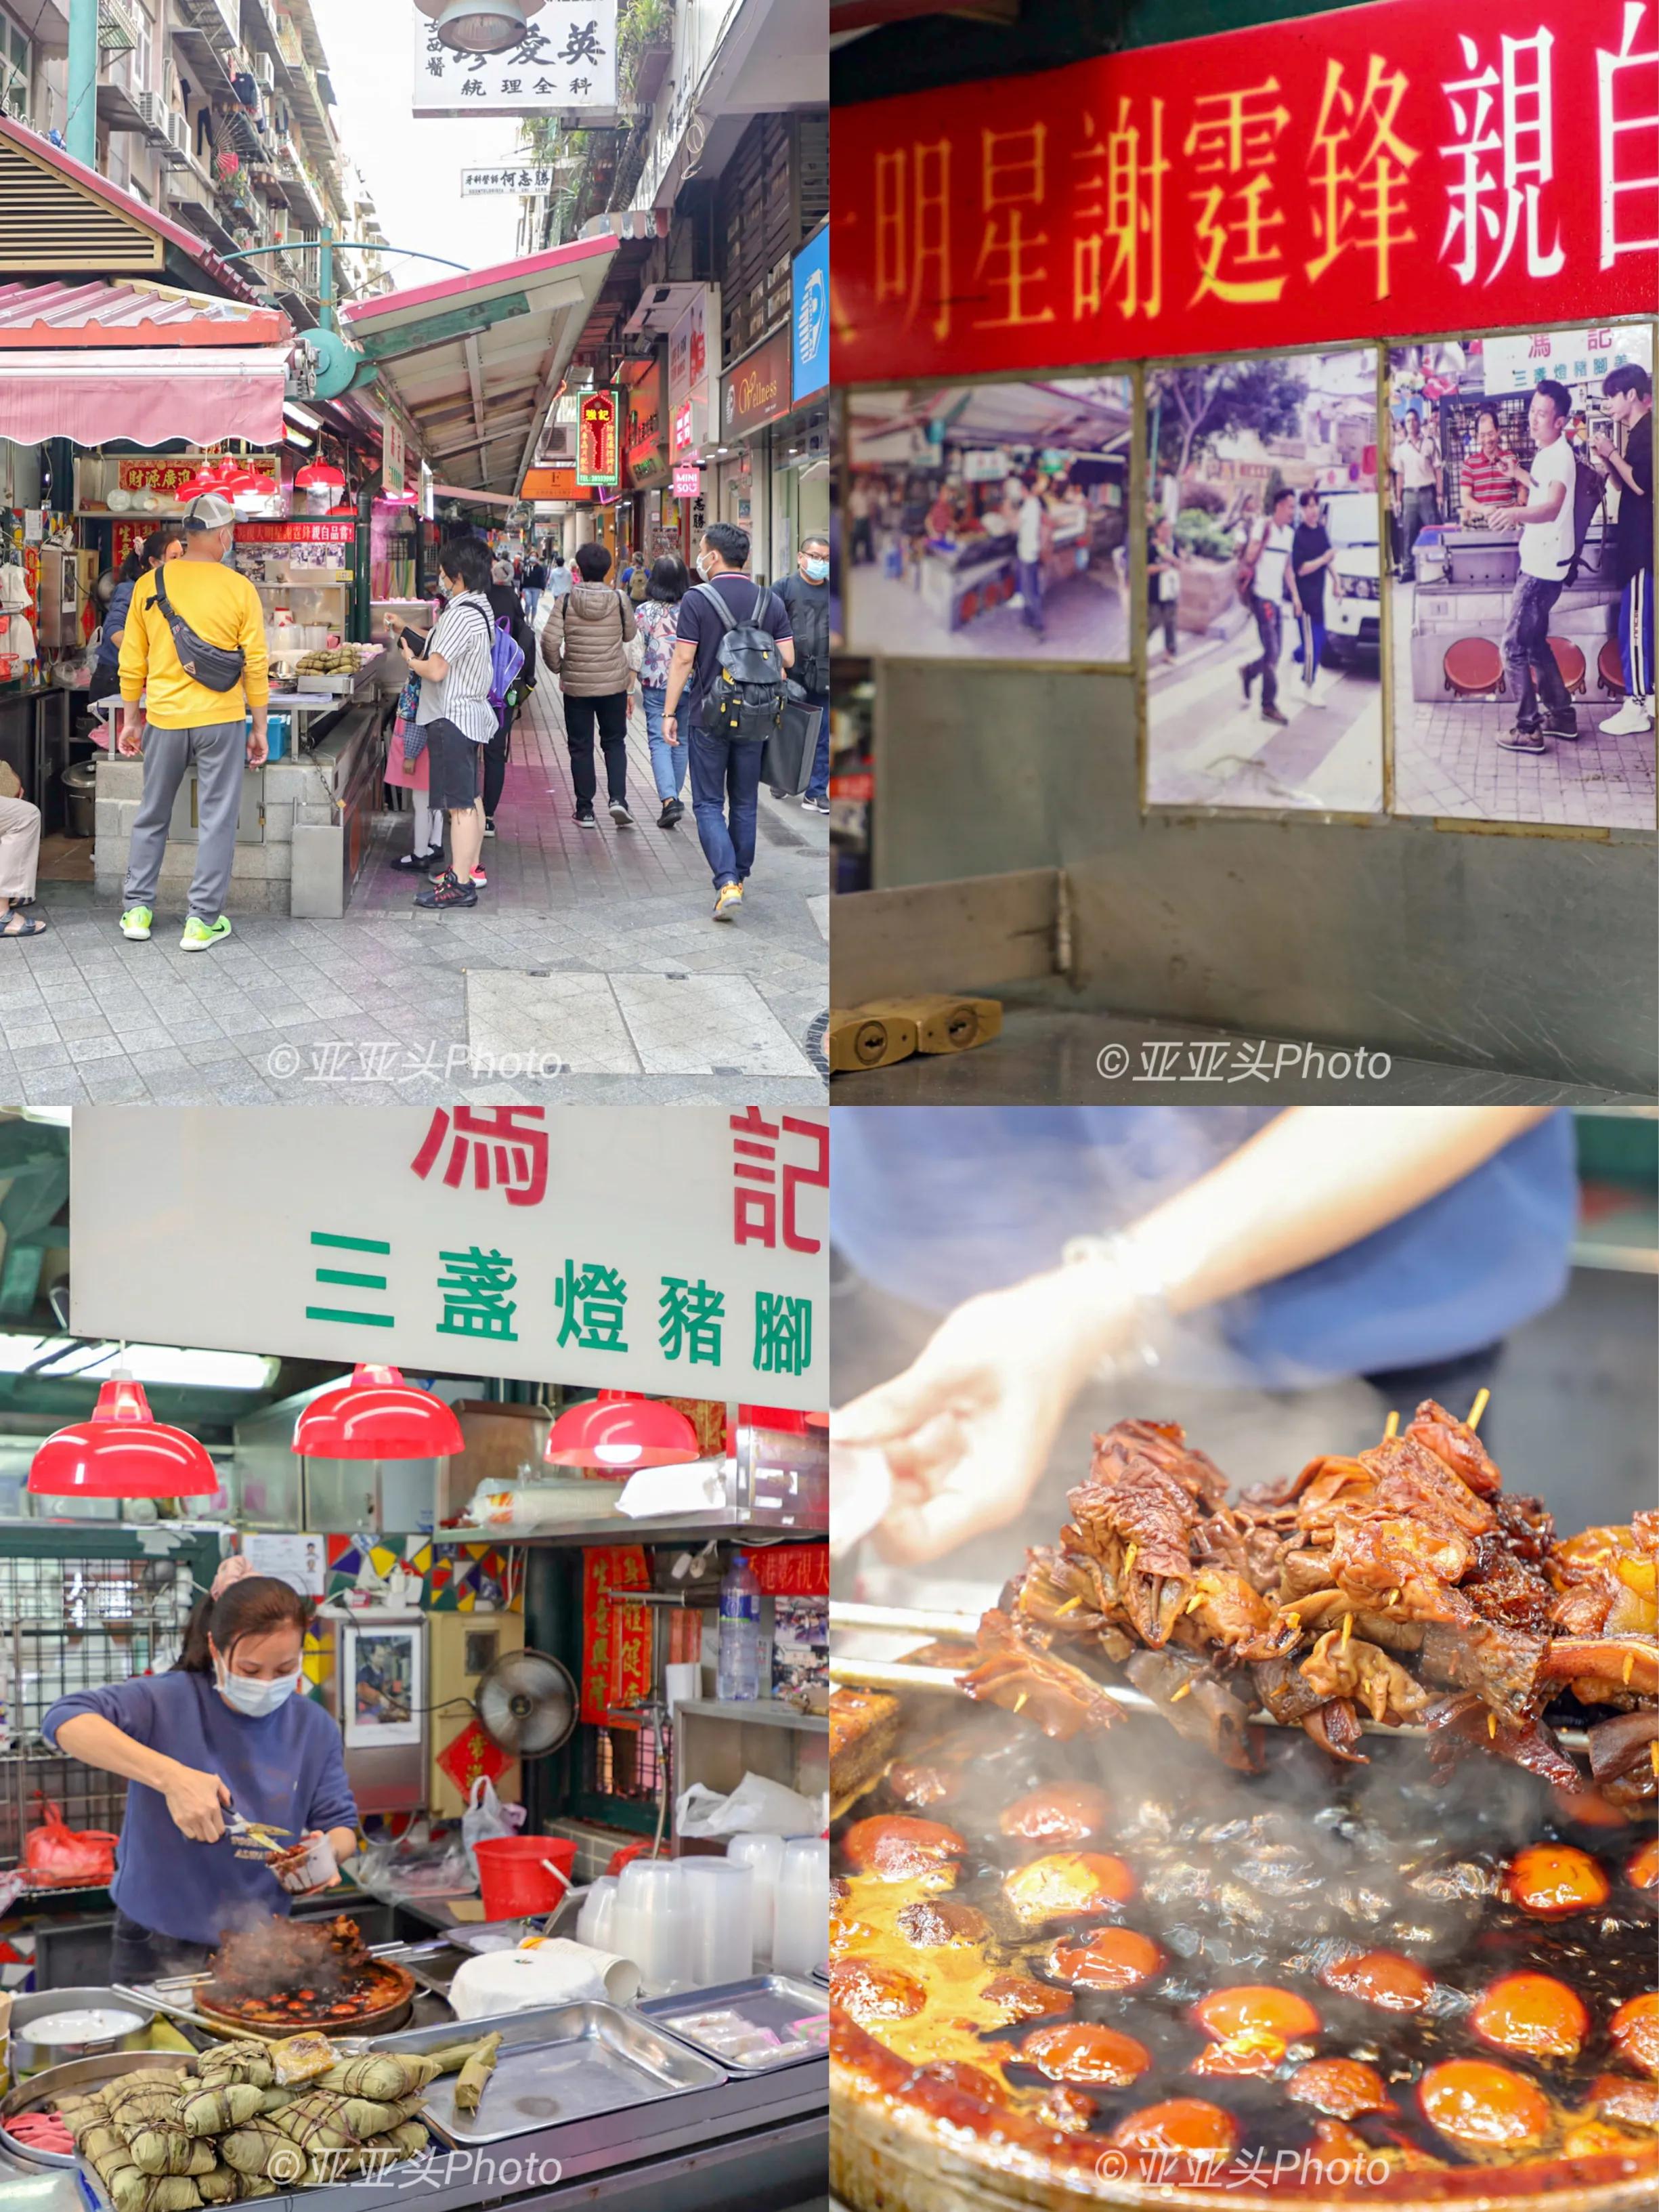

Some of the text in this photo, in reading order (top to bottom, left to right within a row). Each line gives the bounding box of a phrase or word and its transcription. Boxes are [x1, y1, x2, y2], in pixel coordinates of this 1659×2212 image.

[460, 77, 592, 97] 統理全科
[739, 371, 777, 414] Wellness
[677, 473, 697, 482] MINI
[306, 1231, 813, 1376] 三盞燈豬腳
